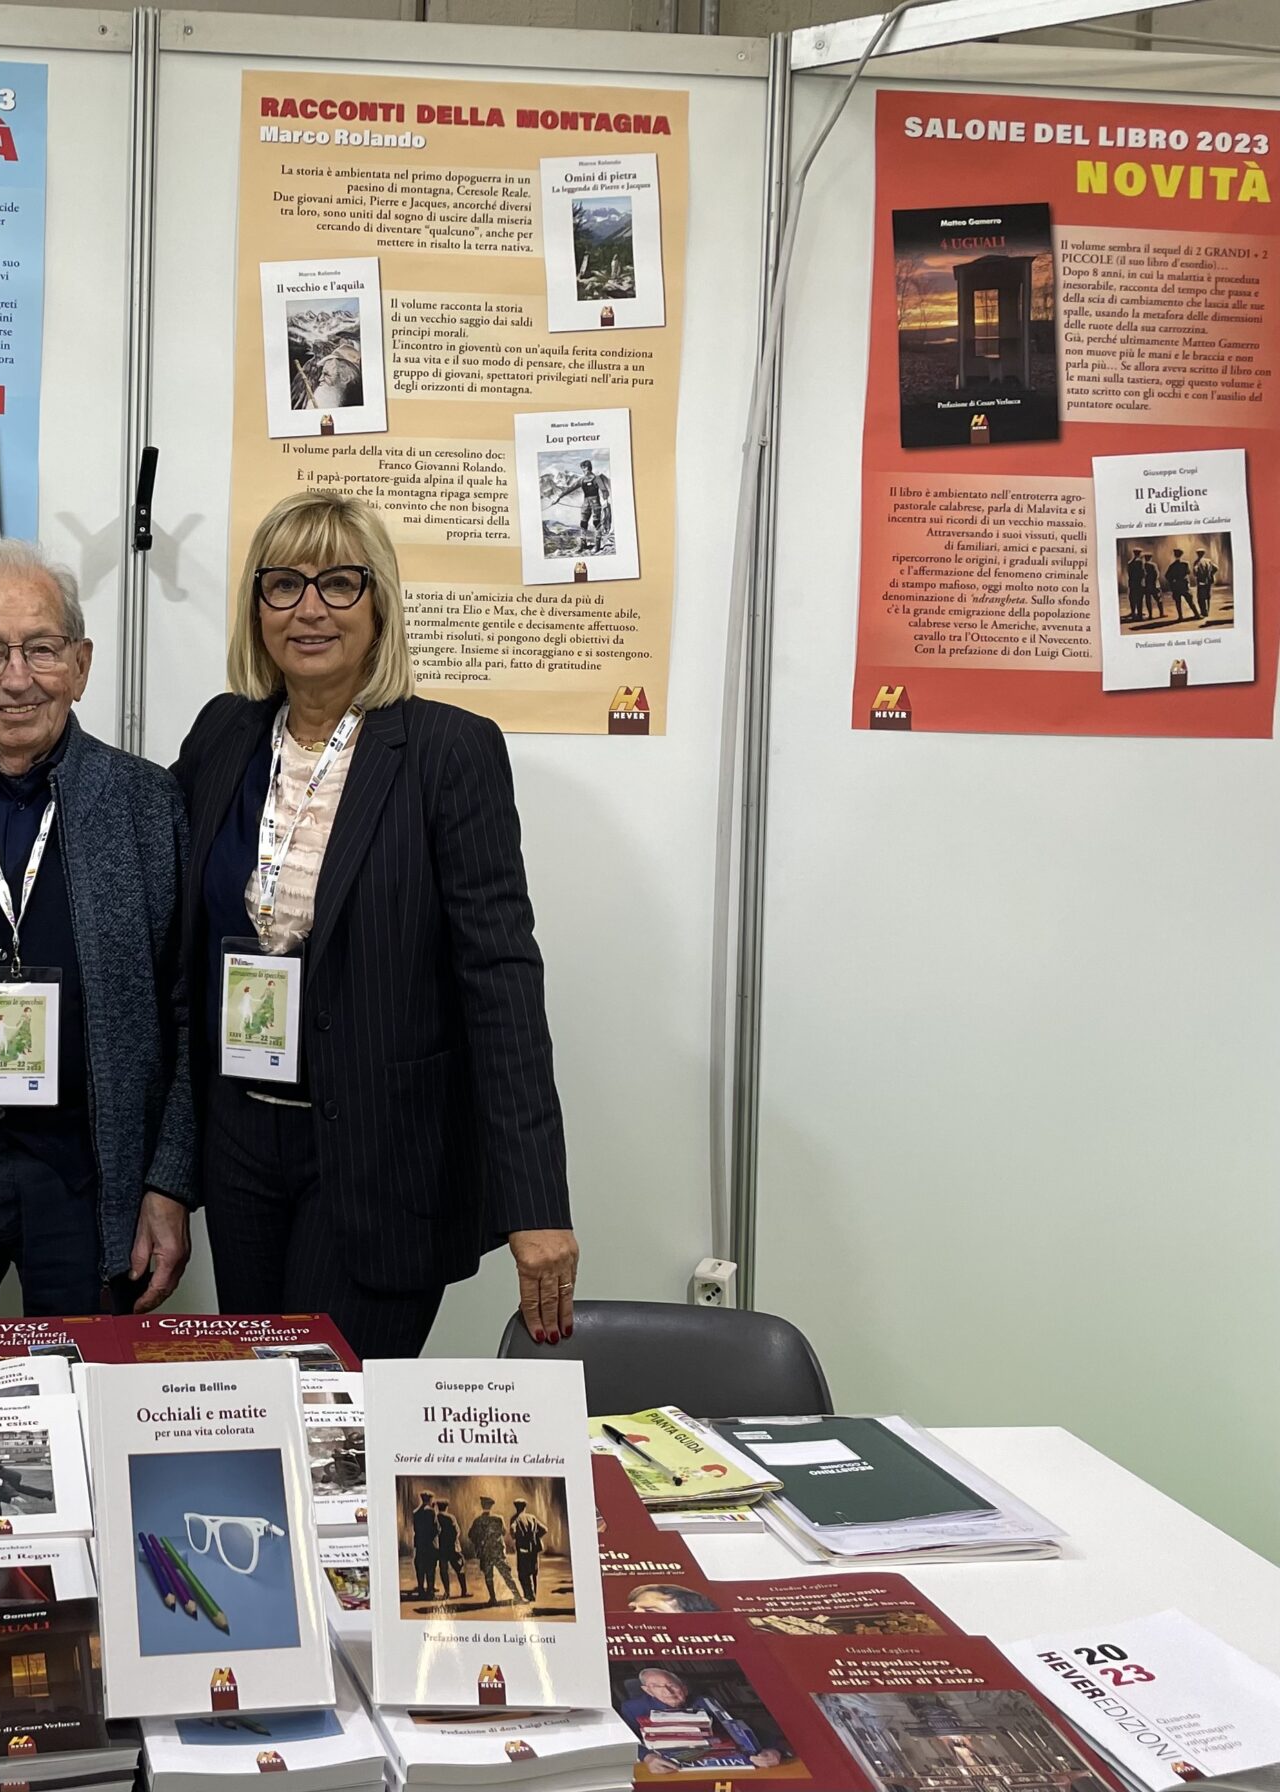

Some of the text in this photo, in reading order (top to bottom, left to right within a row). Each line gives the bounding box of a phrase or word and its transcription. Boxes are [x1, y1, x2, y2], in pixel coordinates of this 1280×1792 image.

[260, 98, 670, 134] RACCONTI DELLA MONTAGNA
[259, 125, 427, 148] Marco Rolando
[904, 116, 1269, 154] SALONE DEL LIBRO 2023
[563, 170, 637, 185] Omini di pietra
[1077, 161, 1271, 202] NOVITÀ
[276, 283, 284, 294] Il
[285, 282, 321, 293] vecchio
[329, 279, 365, 293] l'aquila
[545, 434, 601, 446] Lou porteur
[378, 459, 506, 473] Franco Giovanni Rolando.
[1135, 485, 1208, 501] Il Padiglione
[1144, 499, 1200, 514] di Umiltà
[913, 643, 1093, 660] Con la prefazione di don Luigi Ciotti.
[613, 710, 647, 720] HEVER
[874, 710, 907, 719] HEVER
[158, 1318, 272, 1329] Canavese
[161, 1381, 237, 1393] Gloria Bellino
[434, 1381, 515, 1393] Giuseppe Crupi
[136, 1404, 267, 1422] Occhiali e matite
[423, 1405, 530, 1427] Il Padiglione
[154, 1424, 255, 1441] per una vita colorata
[437, 1427, 518, 1444] di Umiltà
[646, 1412, 705, 1454] PIANTA GUIDA
[393, 1453, 423, 1463] Storie
[423, 1452, 435, 1463] di
[436, 1454, 455, 1463] vita
[464, 1452, 508, 1463] malavita
[509, 1454, 520, 1464] in
[522, 1453, 565, 1464] Calabria
[652, 1632, 736, 1643] di carta
[609, 1645, 724, 1656] di un editore
[1073, 1643, 1129, 1666] 20
[1099, 1663, 1156, 1687] 23
